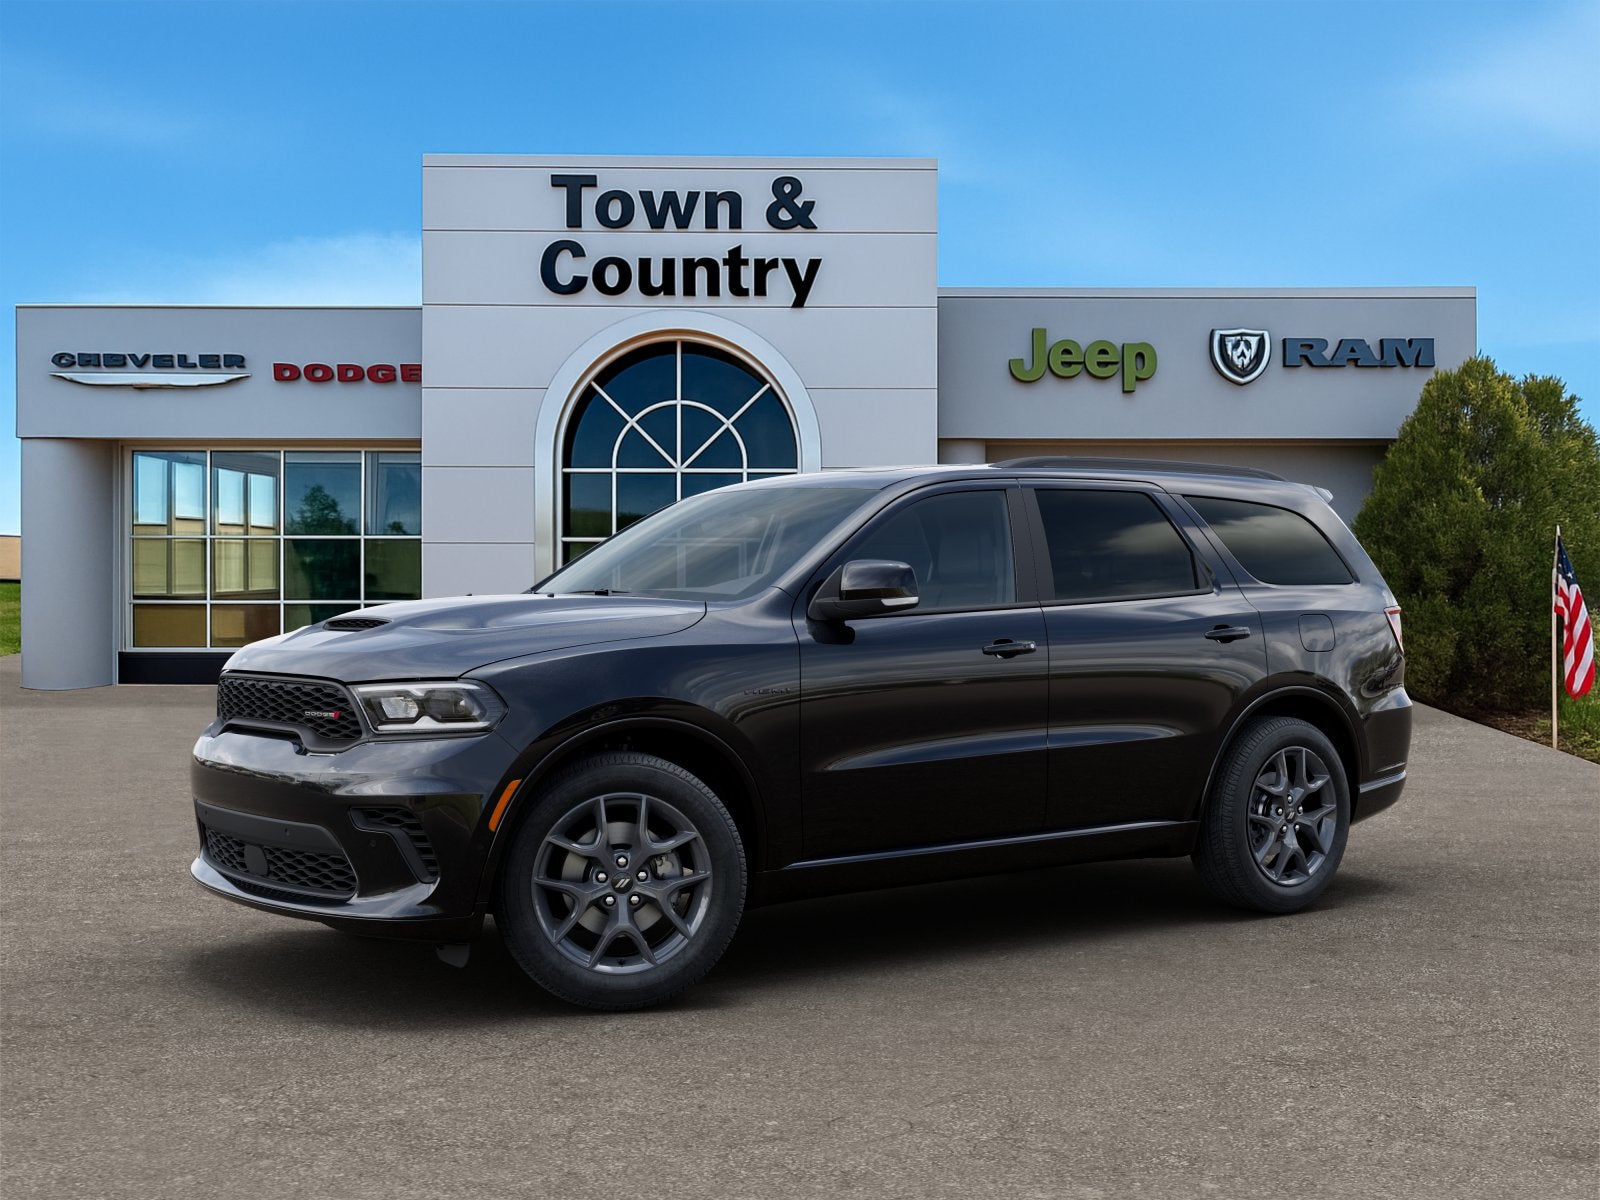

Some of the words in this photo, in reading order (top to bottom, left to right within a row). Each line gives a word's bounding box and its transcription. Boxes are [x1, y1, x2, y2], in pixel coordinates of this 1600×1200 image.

[550, 174, 742, 229] Town
[765, 176, 818, 230] &
[540, 239, 822, 308] Country
[273, 363, 422, 383] DODGE
[1009, 328, 1158, 393] Jeep
[1282, 337, 1435, 368] RAM
